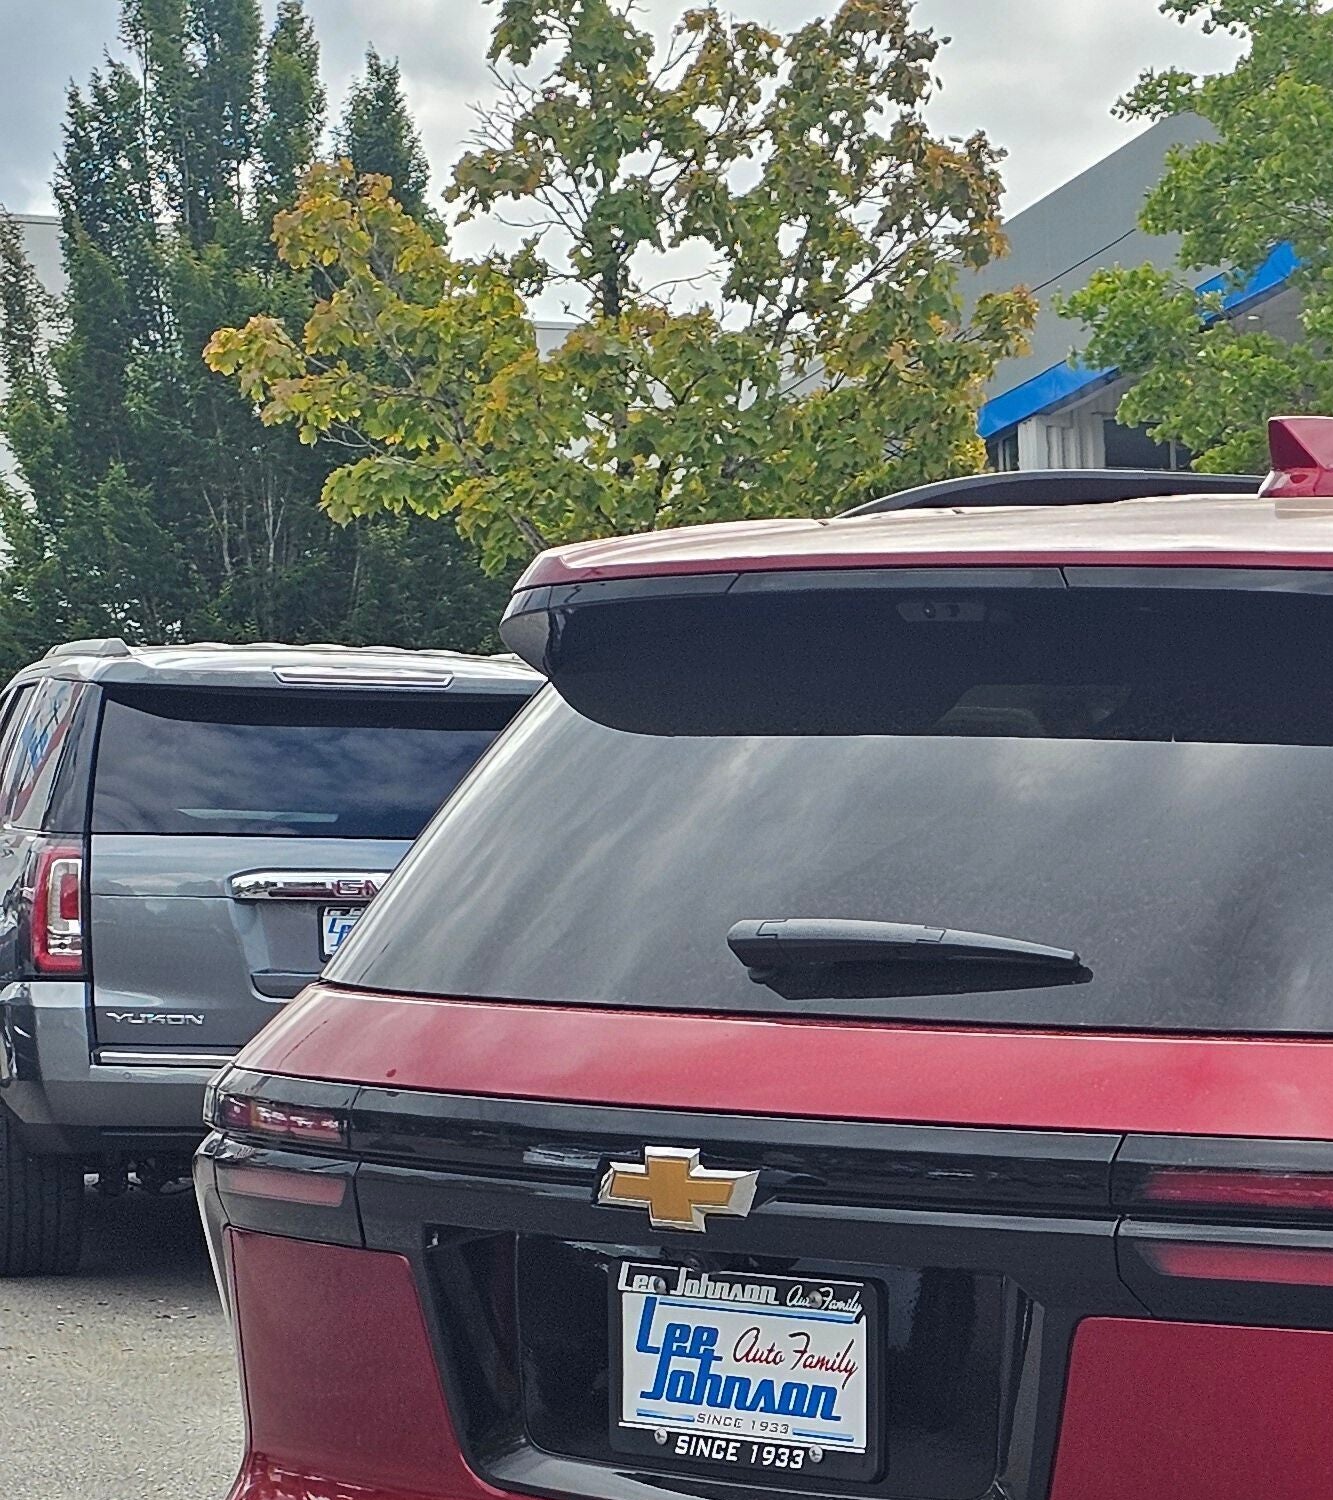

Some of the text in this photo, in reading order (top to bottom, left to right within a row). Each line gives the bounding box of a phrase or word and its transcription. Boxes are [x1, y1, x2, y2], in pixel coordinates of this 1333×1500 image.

[105, 1012, 205, 1025] YUKON
[670, 1267, 779, 1305] Johnson
[819, 1287, 862, 1320] Family
[636, 1296, 723, 1361] Lee
[733, 1327, 858, 1390] Auto Family
[640, 1350, 842, 1421] Johnson
[696, 1413, 790, 1435] SINCE 1933
[674, 1435, 805, 1469] SINCE 1933
